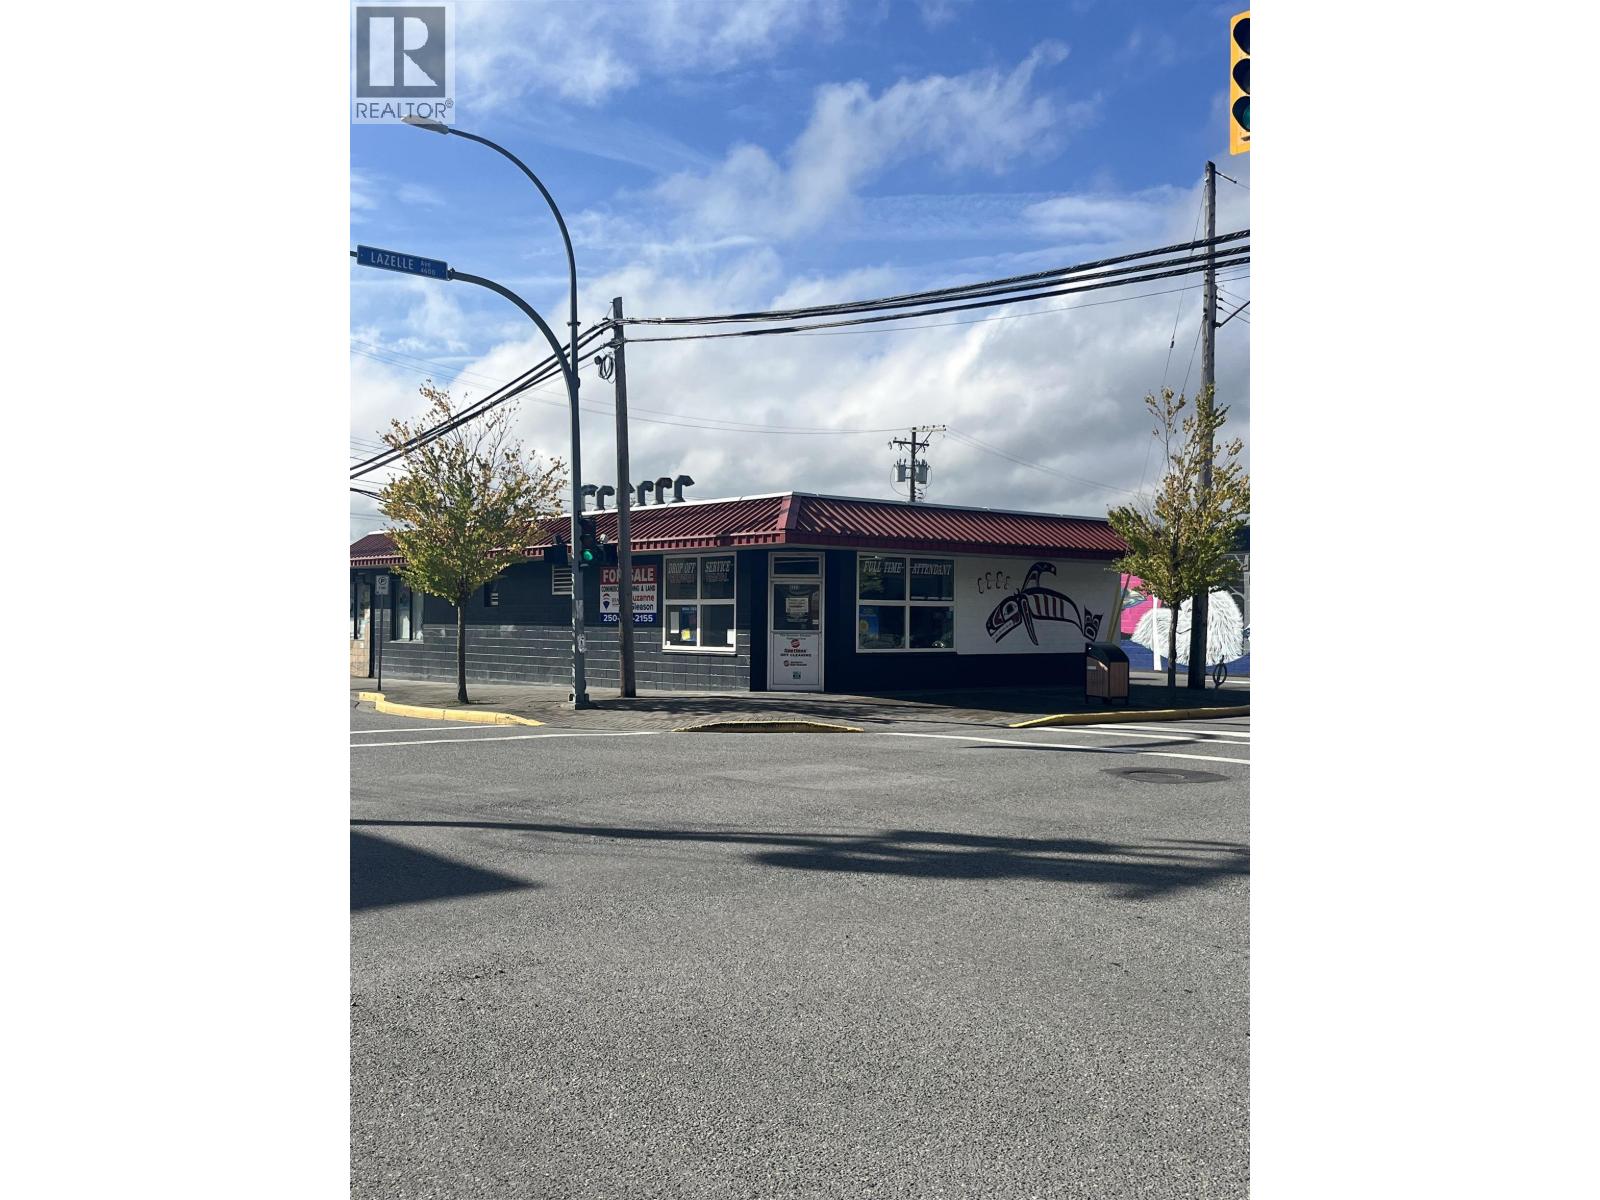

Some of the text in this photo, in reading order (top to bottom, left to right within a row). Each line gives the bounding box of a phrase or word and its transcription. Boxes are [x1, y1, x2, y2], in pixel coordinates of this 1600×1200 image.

[371, 251, 414, 270] LAZELLE
[704, 560, 731, 573] SERVICE
[863, 561, 881, 573] FULL
[911, 563, 952, 576] ATTENDANT
[632, 567, 654, 582] ALE
[603, 614, 654, 623] 250--2155
